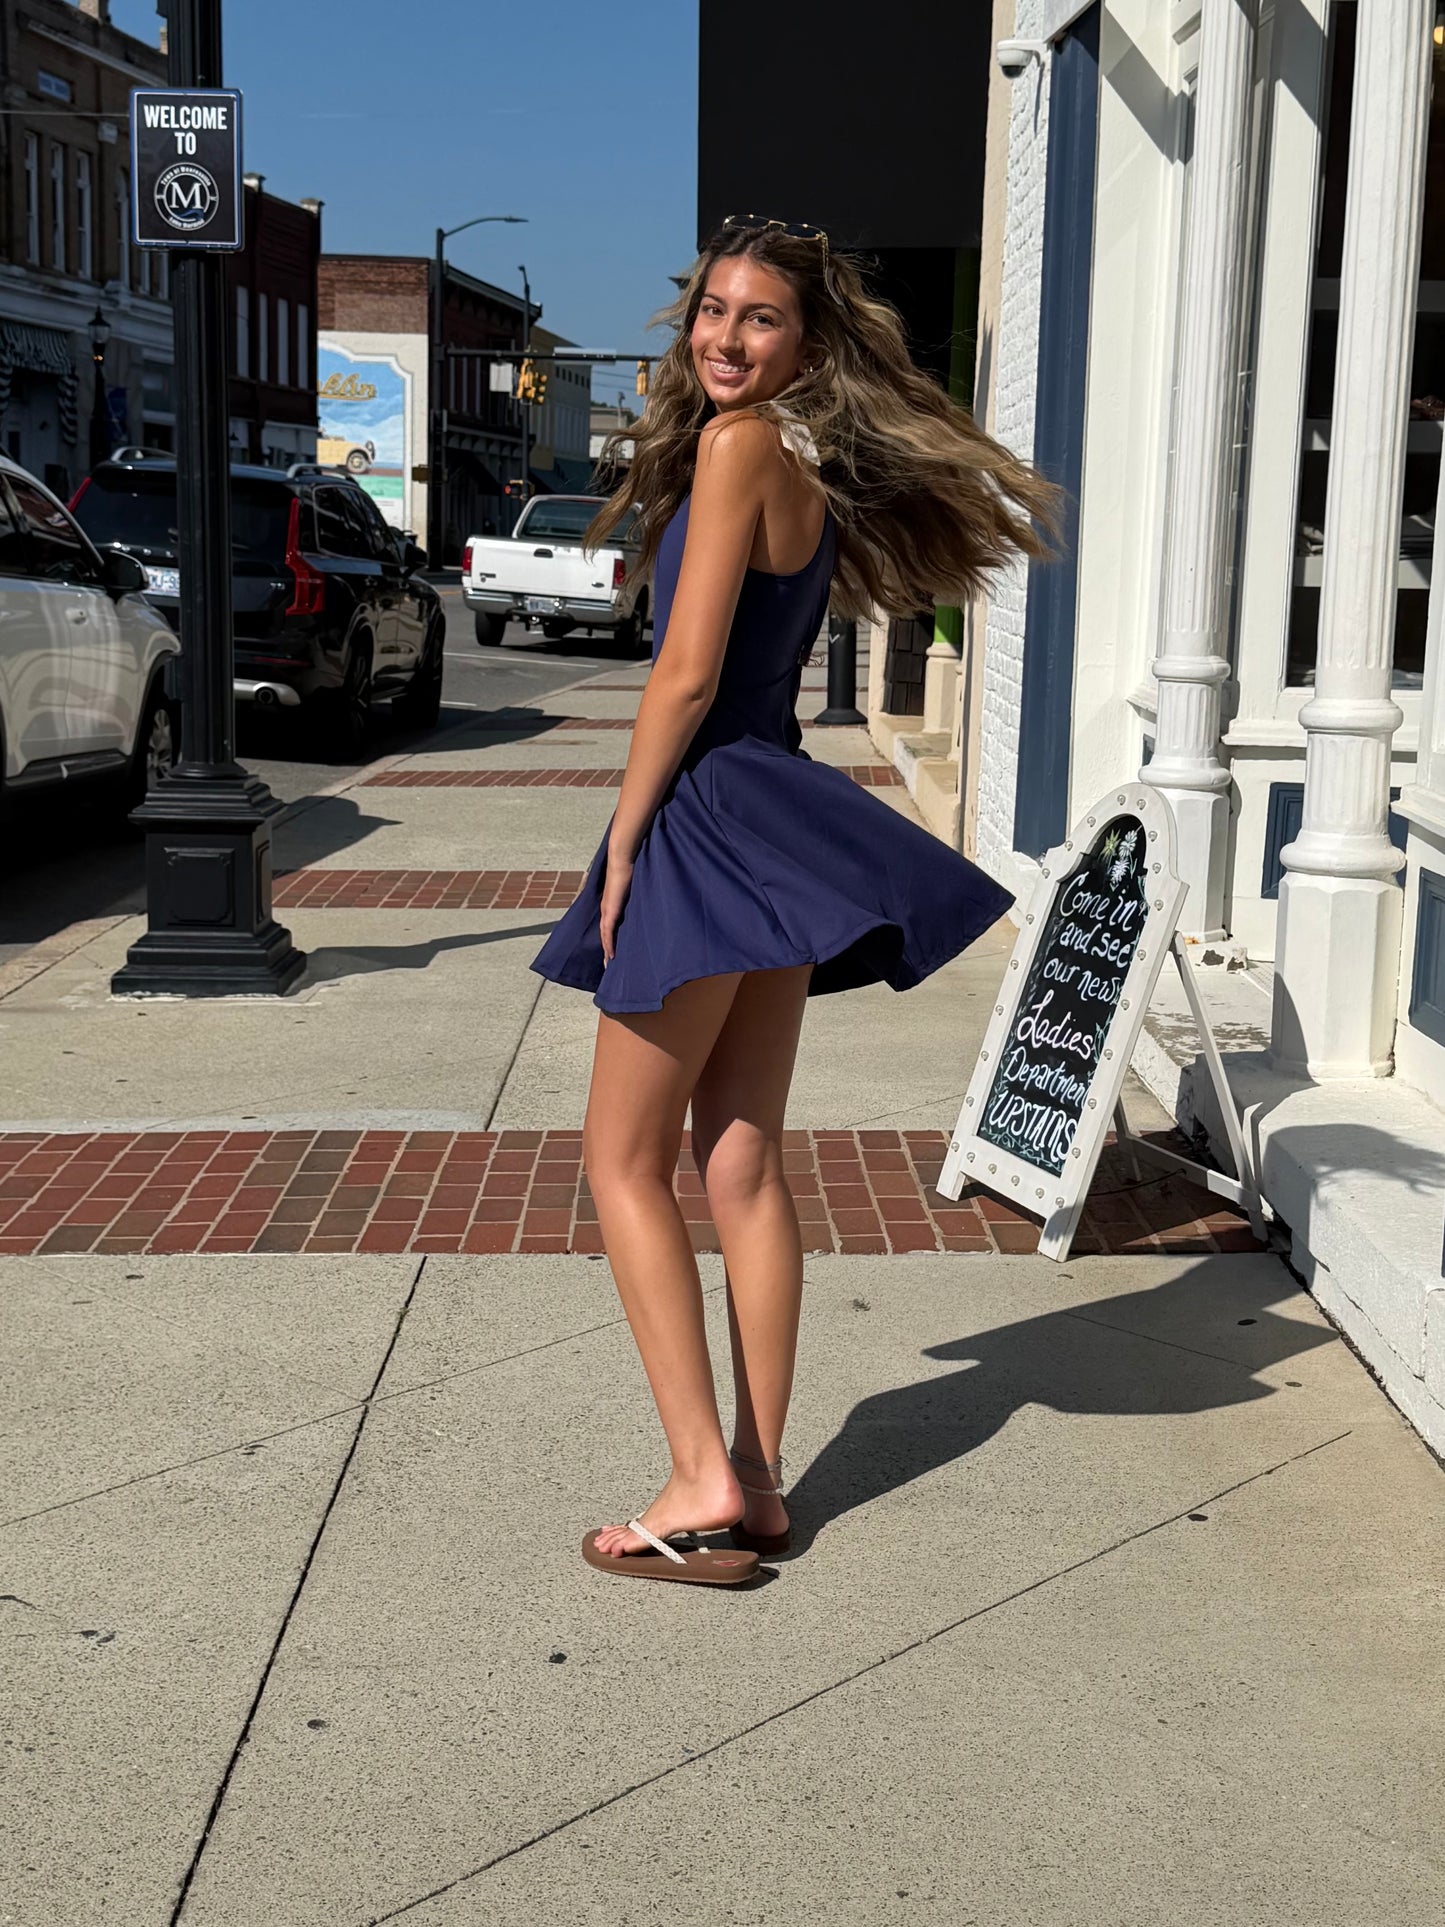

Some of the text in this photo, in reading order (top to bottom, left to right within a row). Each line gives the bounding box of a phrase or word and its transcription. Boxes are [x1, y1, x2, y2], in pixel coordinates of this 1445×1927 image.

[143, 105, 227, 130] WELCOME
[174, 132, 197, 155] TO
[170, 181, 204, 209] M
[1061, 871, 1138, 931] Come in
[1060, 922, 1131, 968] and see
[1043, 957, 1121, 1002] our new
[1017, 989, 1093, 1060] Ladies
[989, 1090, 1077, 1162] UPSTAIRS
